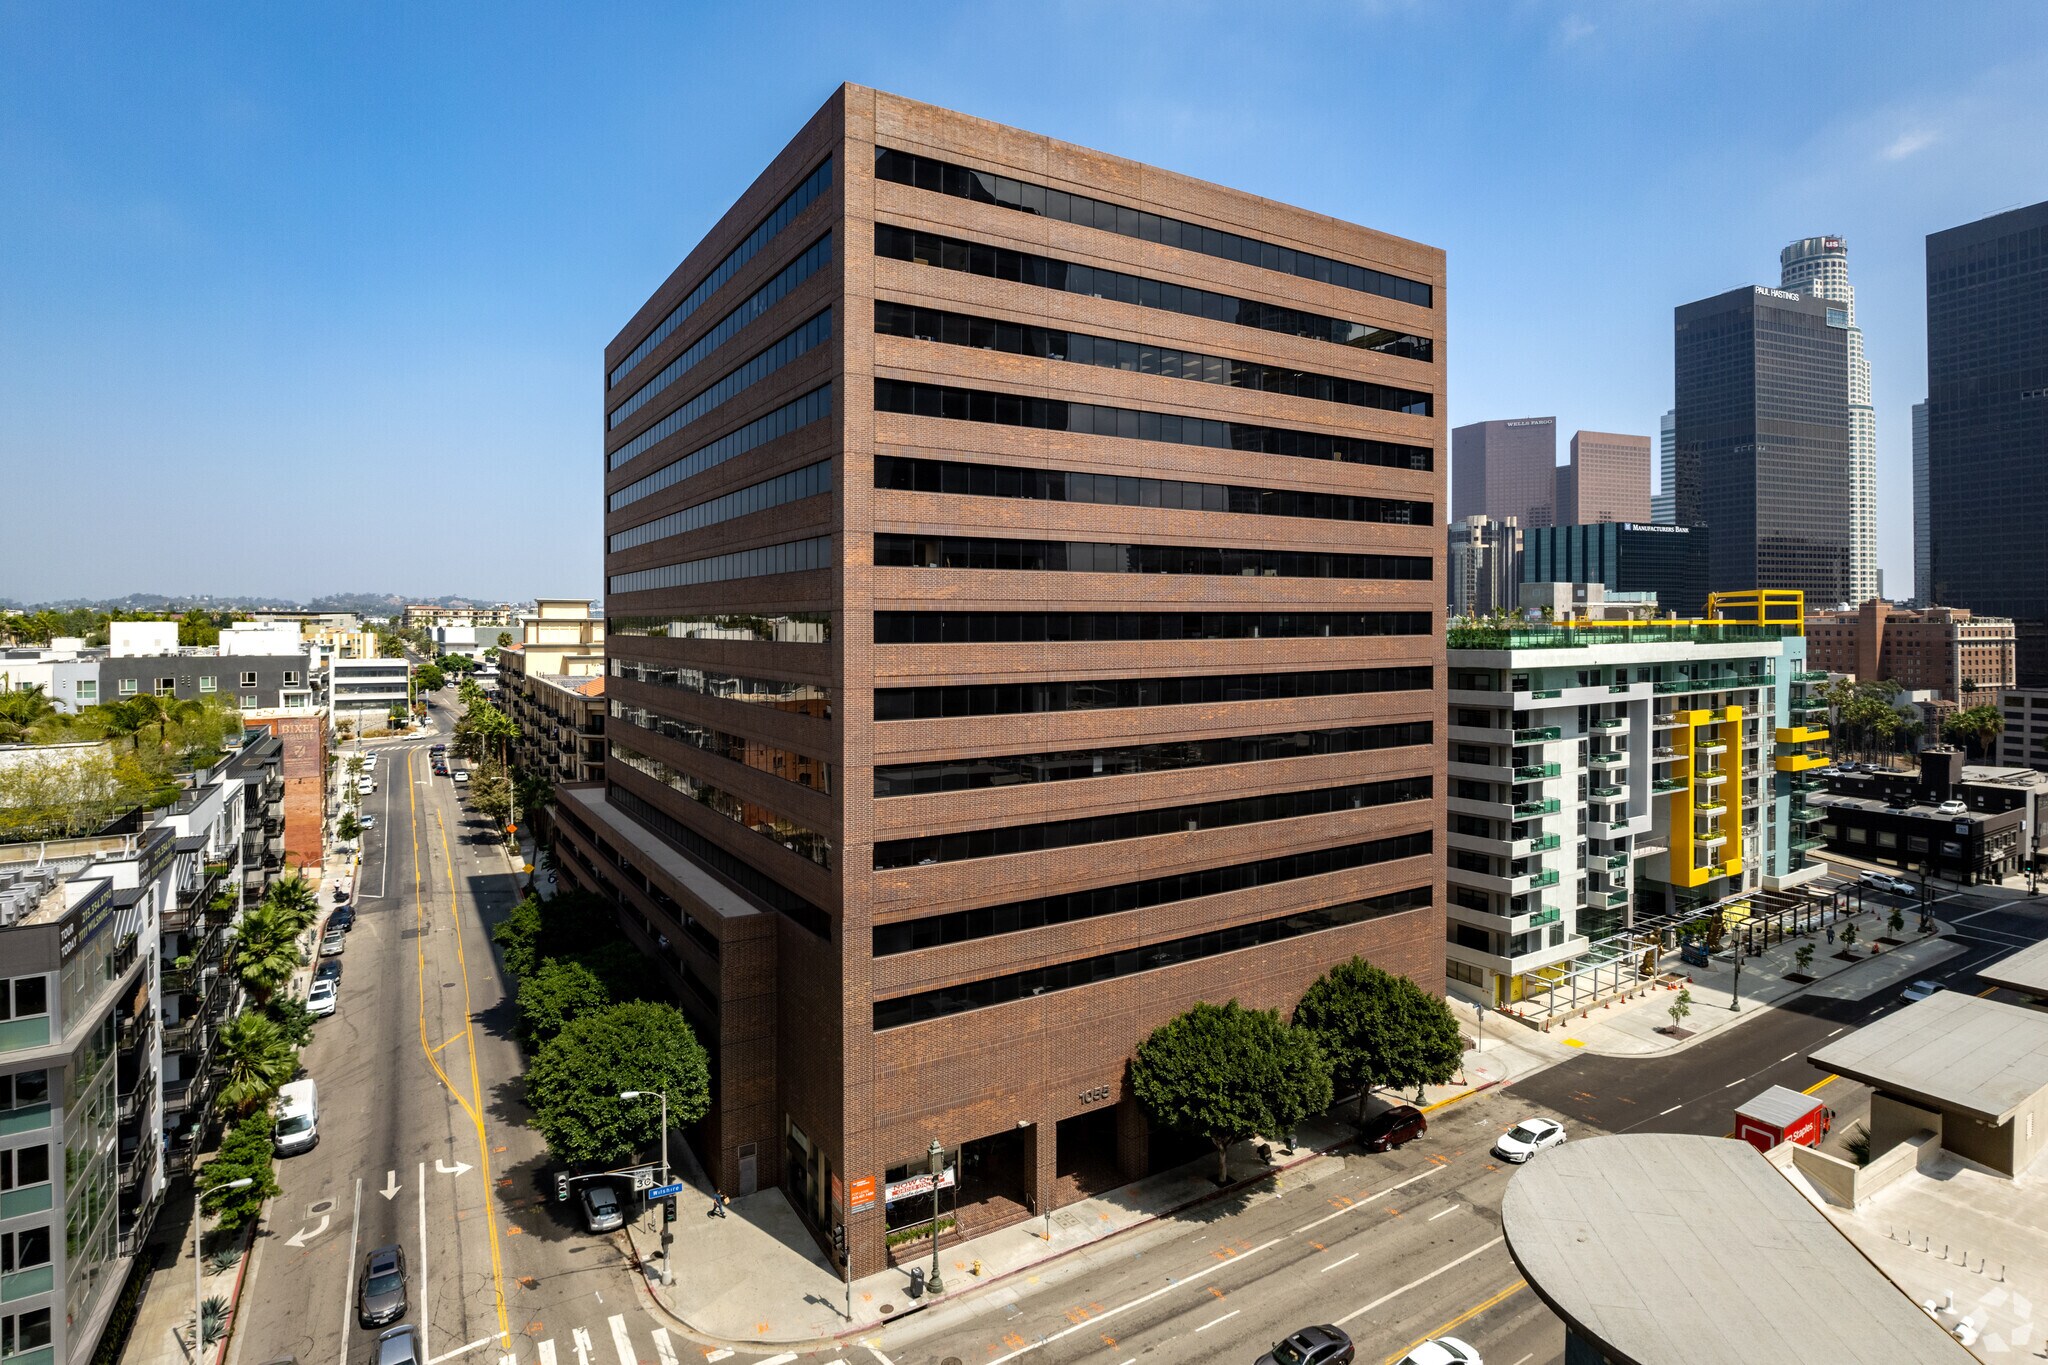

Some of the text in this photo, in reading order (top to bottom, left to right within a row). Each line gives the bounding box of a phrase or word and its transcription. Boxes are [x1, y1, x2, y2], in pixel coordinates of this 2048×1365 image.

[1755, 286, 1800, 301] PAUL HASTINGS
[281, 724, 317, 733] BIXEL
[61, 922, 74, 942] TOUR
[61, 934, 78, 958] TODAY
[1078, 1084, 1110, 1105] 1055
[1792, 1122, 1814, 1141] Staples
[652, 1186, 680, 1196] Wilshire
[893, 1179, 917, 1190] NOW
